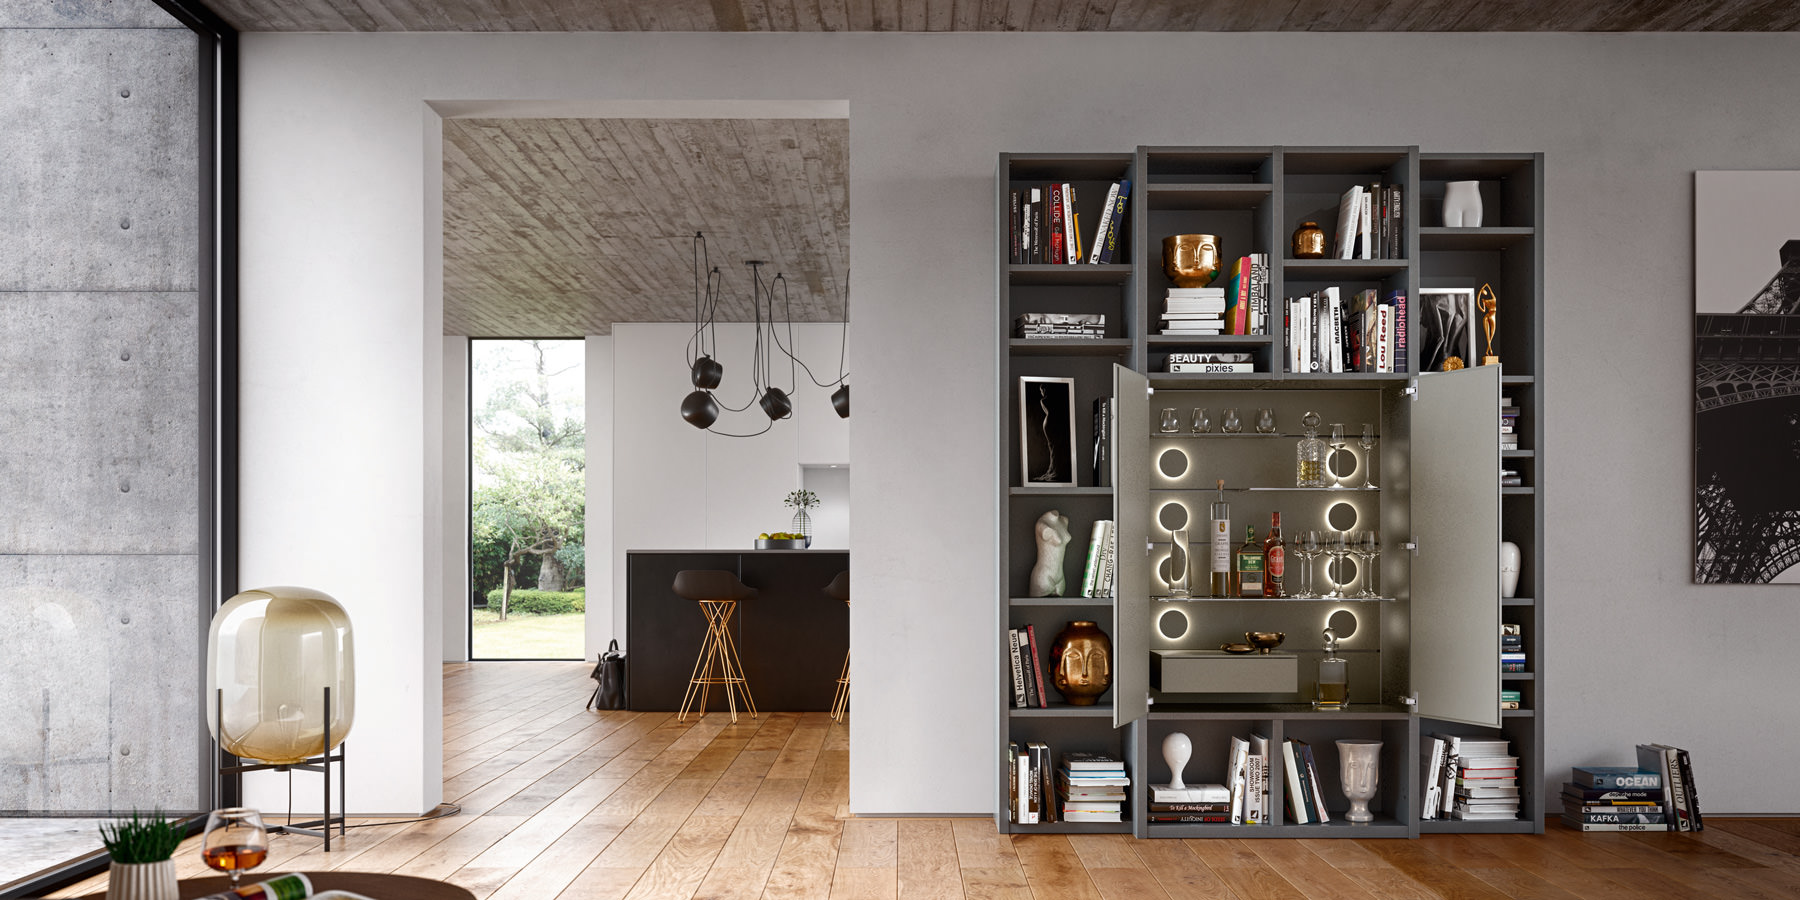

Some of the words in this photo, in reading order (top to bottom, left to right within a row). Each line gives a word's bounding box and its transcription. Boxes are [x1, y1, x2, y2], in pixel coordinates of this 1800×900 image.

[1100, 208, 1112, 235] NAKED
[1108, 189, 1118, 207] NOW
[1251, 264, 1259, 312] TIMBALAND
[1397, 296, 1406, 348] radiohead
[1170, 354, 1212, 363] BEAUTY
[1206, 364, 1234, 373] pixies
[1014, 655, 1023, 691] Helvetica
[1616, 777, 1657, 786] OCEAN
[1671, 759, 1684, 804] OUTLIERS
